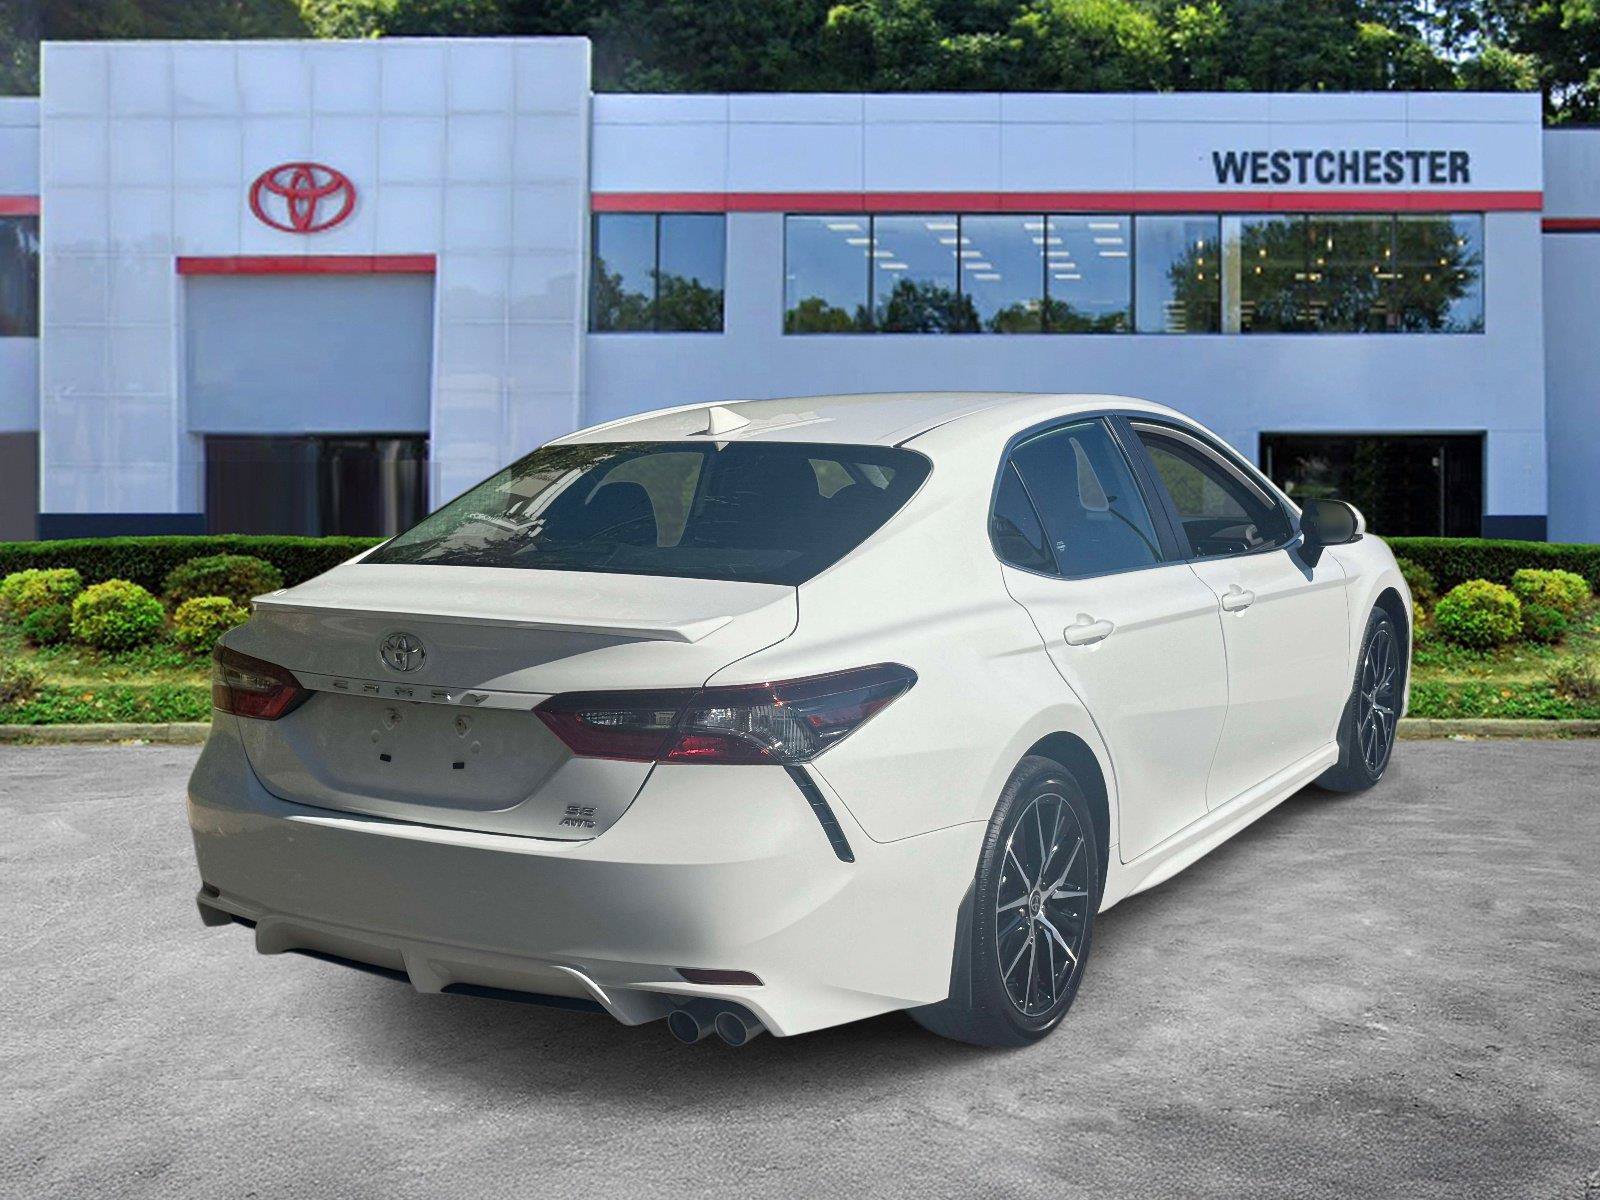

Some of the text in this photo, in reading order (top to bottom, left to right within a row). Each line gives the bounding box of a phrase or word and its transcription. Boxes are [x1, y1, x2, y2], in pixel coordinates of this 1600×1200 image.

[1212, 150, 1471, 184] WESTCHESTER
[333, 679, 490, 706] CAMRY
[558, 817, 596, 828] AWD
